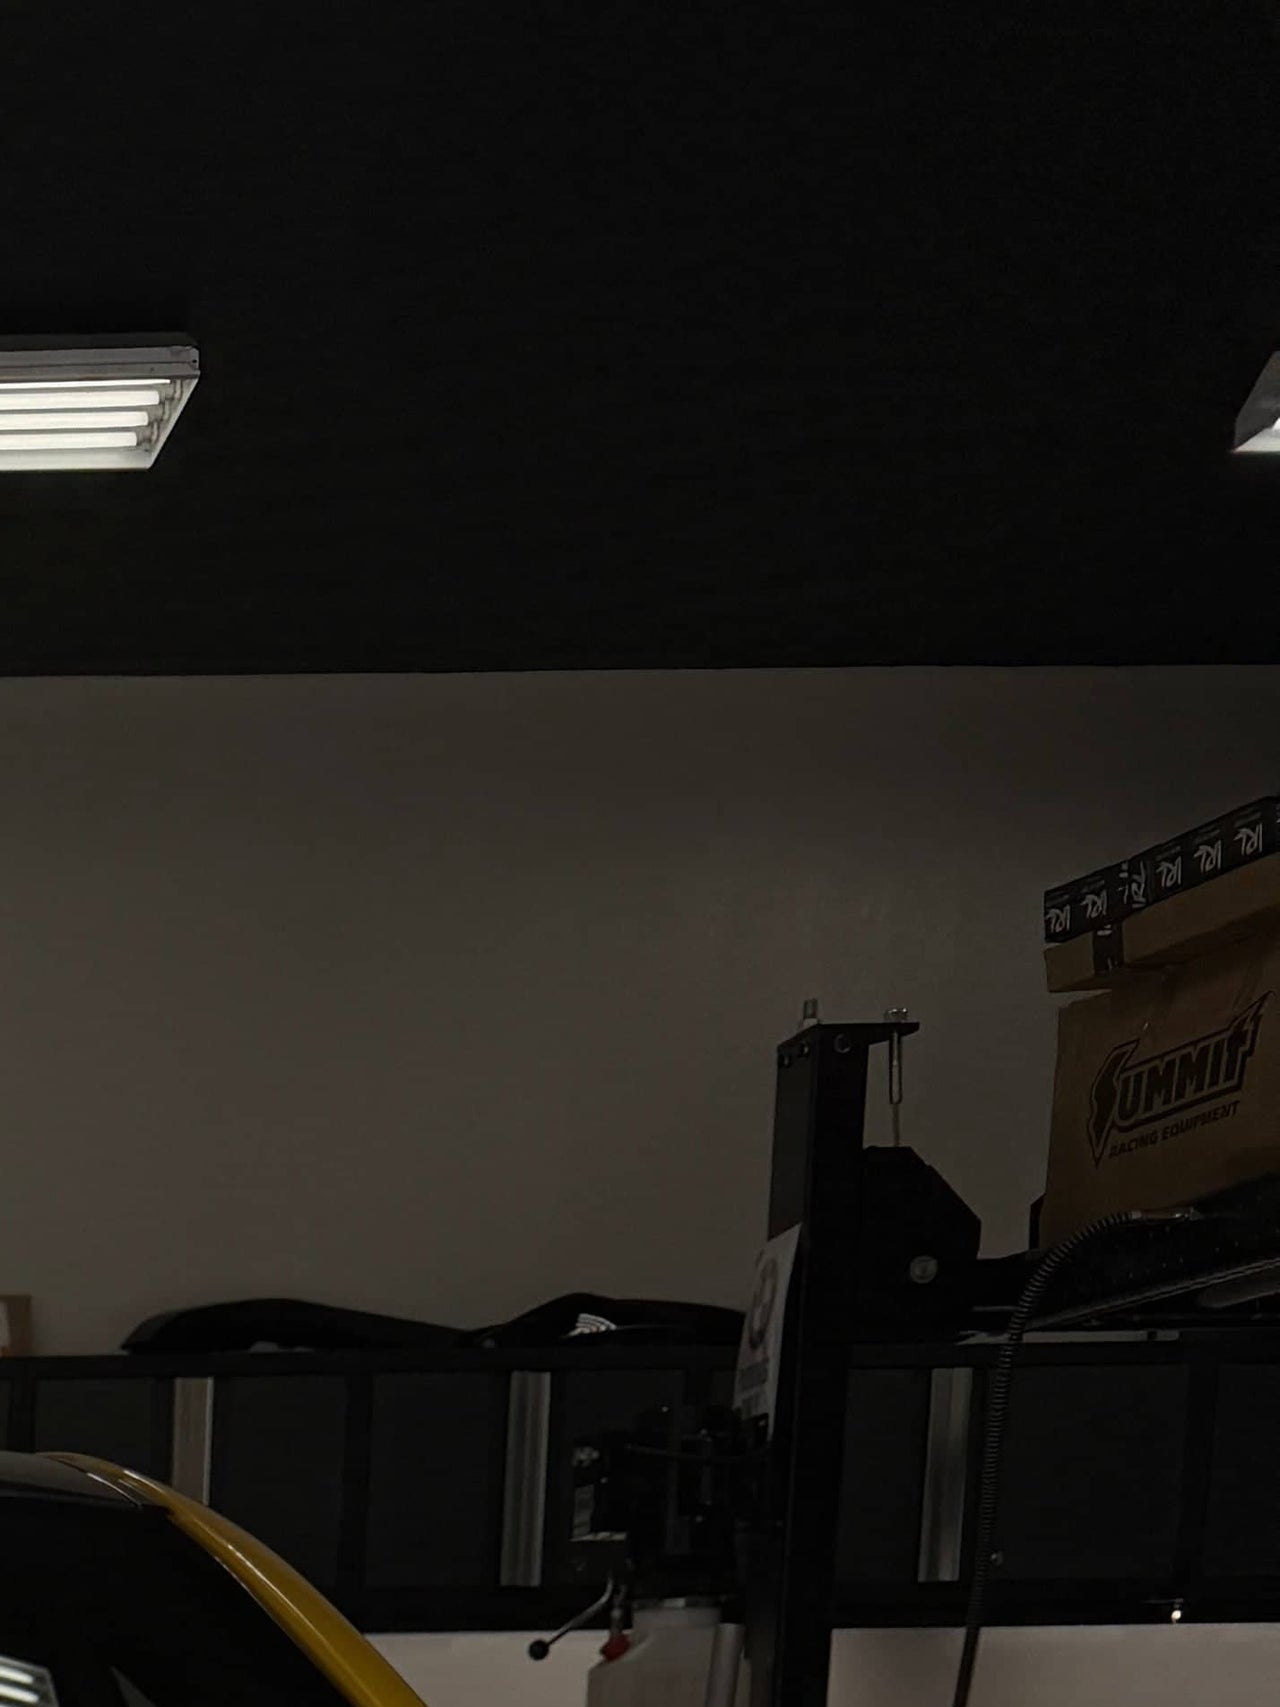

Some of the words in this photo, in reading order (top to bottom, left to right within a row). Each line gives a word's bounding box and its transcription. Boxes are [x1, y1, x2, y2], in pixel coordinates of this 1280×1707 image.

[1087, 991, 1273, 1168] SUMMIT
[1109, 1131, 1159, 1158] RACING
[1162, 1100, 1240, 1140] EQUIPMENT
